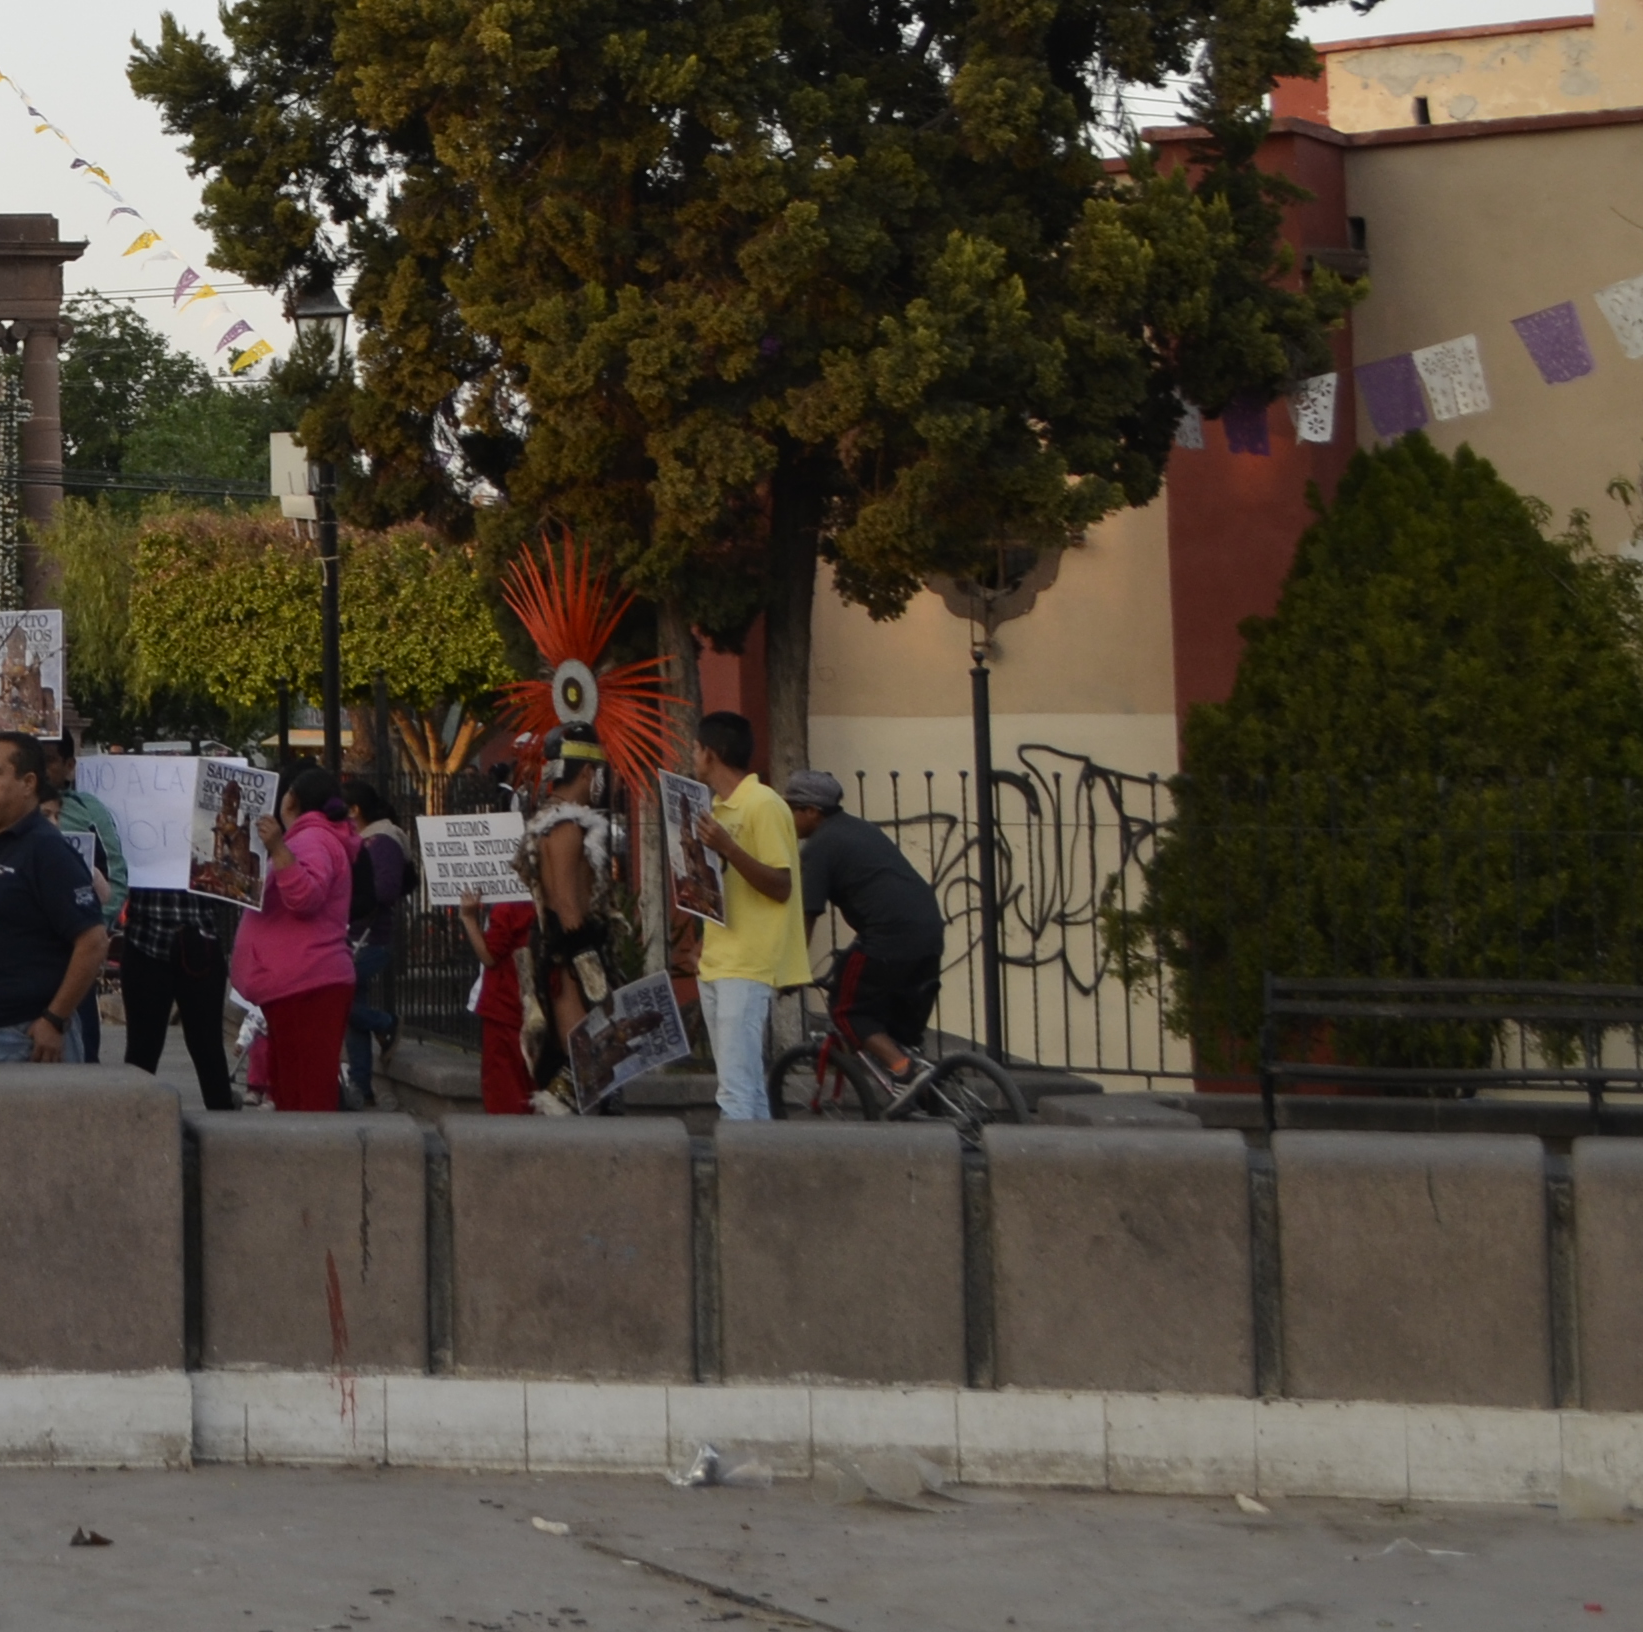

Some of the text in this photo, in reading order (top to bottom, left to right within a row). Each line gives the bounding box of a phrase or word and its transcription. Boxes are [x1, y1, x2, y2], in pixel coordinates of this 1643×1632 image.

[127, 763, 145, 795] A
[154, 765, 185, 793] LA
[206, 763, 265, 788] SAUCITO
[445, 821, 490, 837] EXIGIMOS
[424, 842, 436, 857] SE
[473, 838, 521, 856] ESTUDIOS
[437, 863, 450, 878] EN
[451, 862, 498, 878] MECANICA
[430, 882, 463, 897] SUELOS
